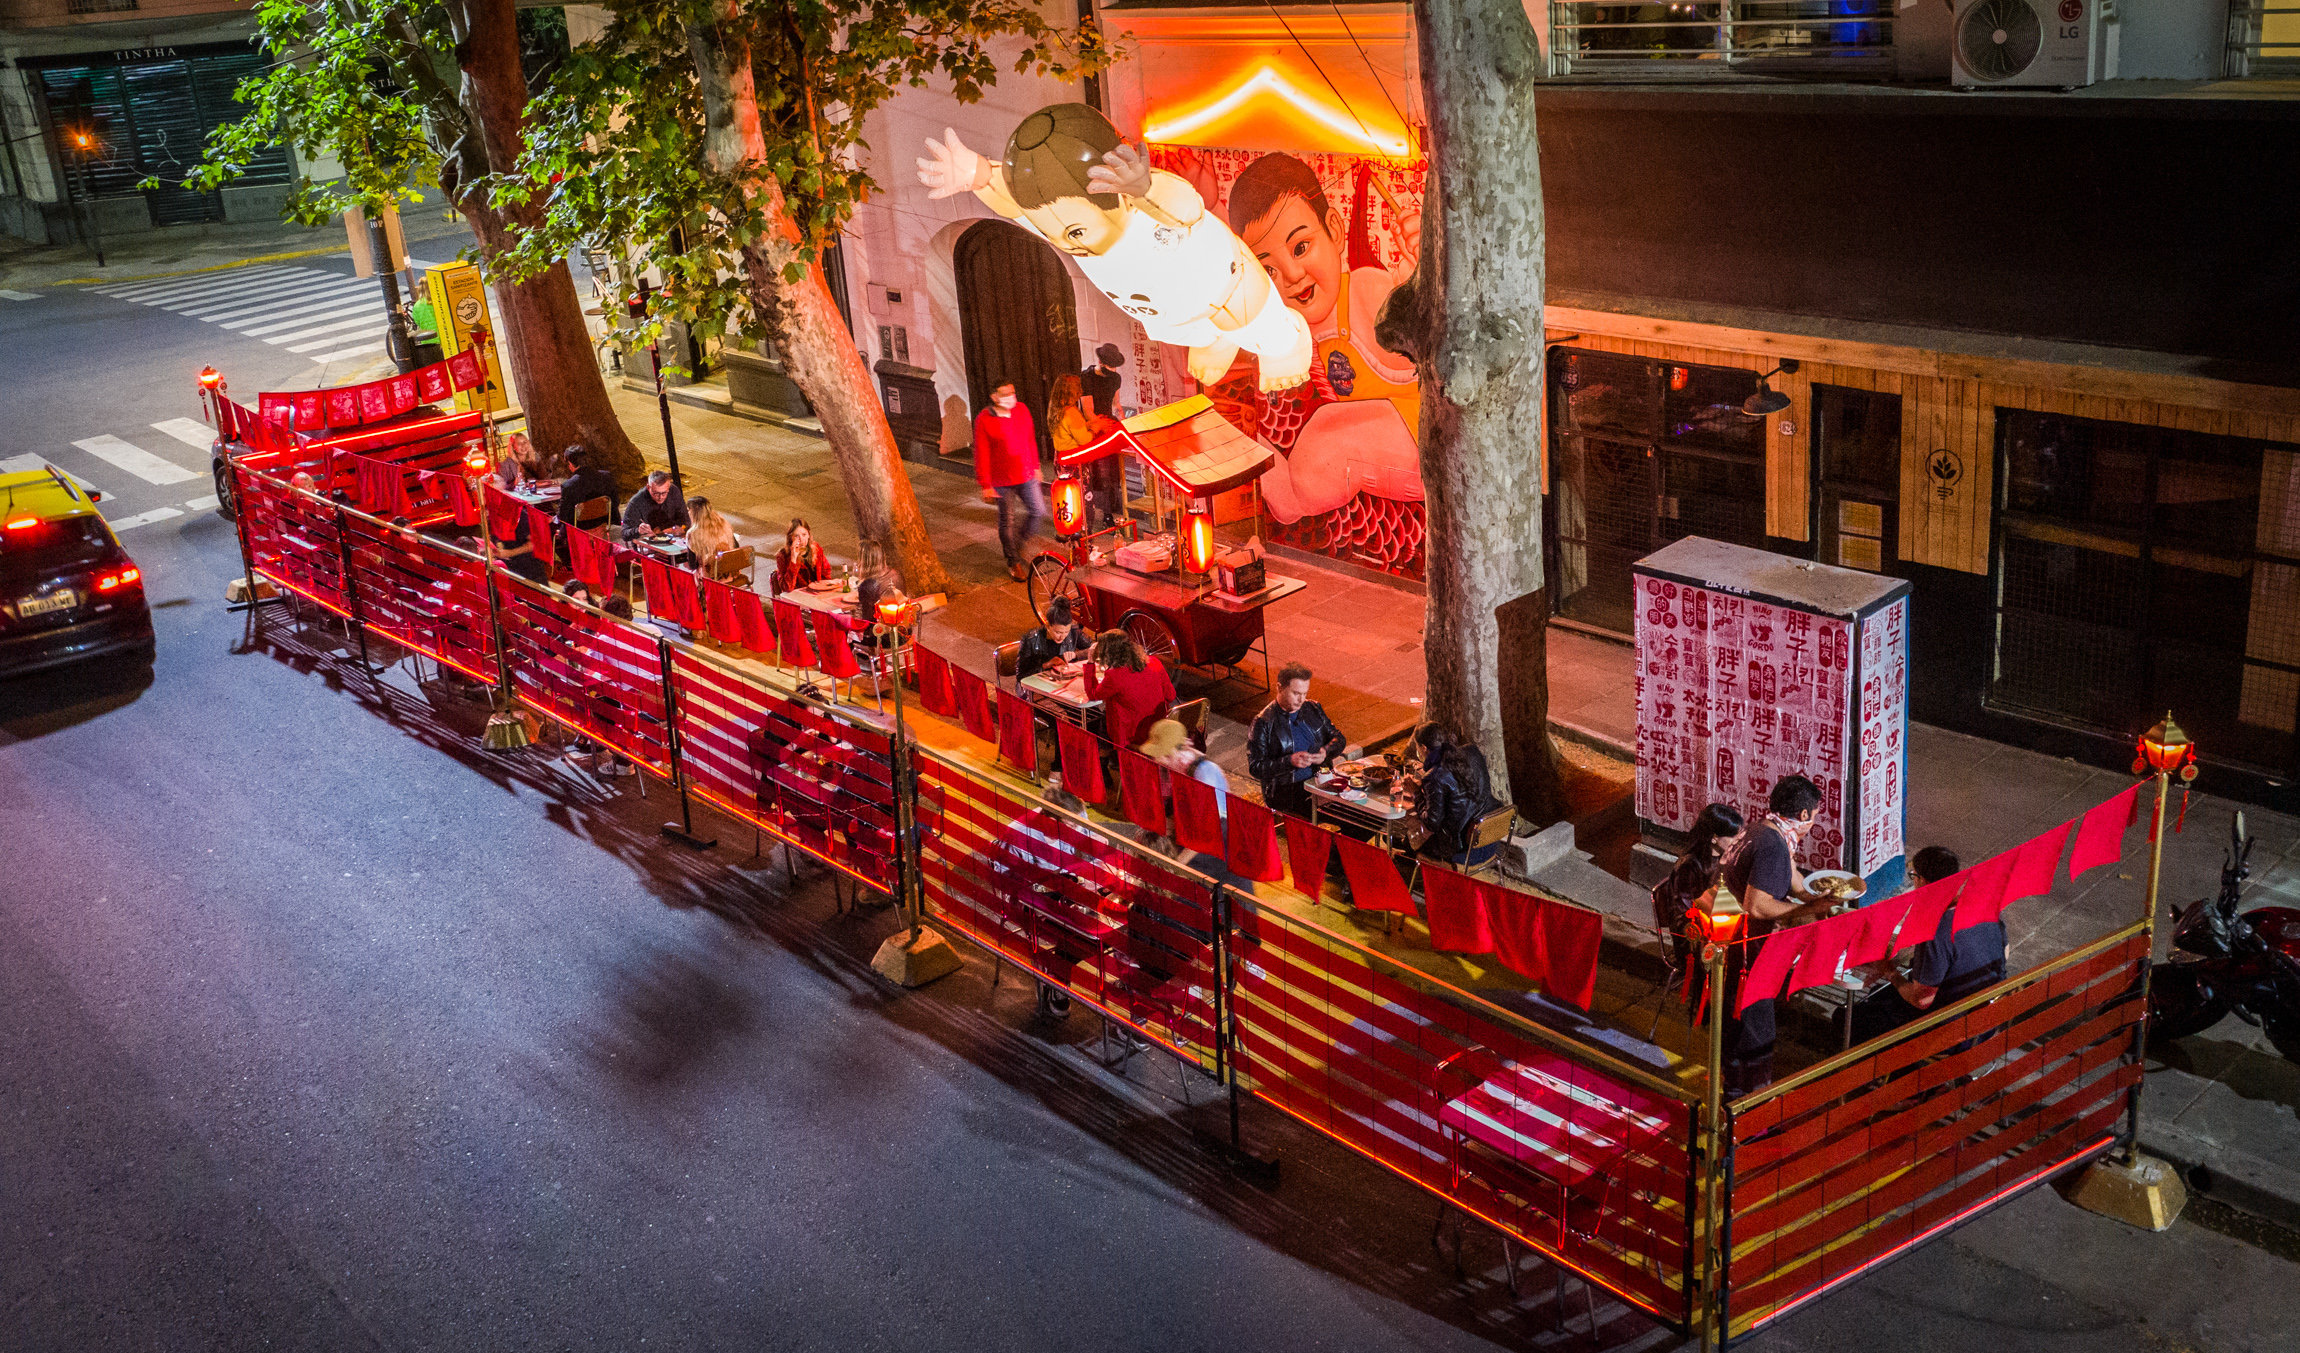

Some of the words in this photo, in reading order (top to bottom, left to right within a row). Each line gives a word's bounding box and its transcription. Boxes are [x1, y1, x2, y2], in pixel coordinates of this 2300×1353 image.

[2060, 26, 2079, 38] LG
[114, 47, 176, 60] TINTHA
[450, 281, 478, 290] SANITIZANTE
[1056, 500, 1073, 523] 福
[1648, 580, 1677, 599] 最好
[1656, 597, 1669, 612] 的
[1713, 595, 1744, 618] 치킨
[1752, 604, 1772, 616] NIÑO
[1648, 609, 1677, 628] 朋友
[1785, 610, 1811, 661] 胖子
[1887, 602, 1903, 656] 胖子
[1664, 634, 1678, 648] 수
[1748, 639, 1774, 652] GORDO
[1716, 646, 1740, 694] 胖子
[1895, 655, 1904, 669] 수
[1763, 665, 1775, 703] 永遠に
[1781, 662, 1814, 687] 치킨
[1657, 683, 1675, 694] NIÑO
[1683, 689, 1712, 710] 太った
[1715, 698, 1746, 721] 치킨
[1654, 716, 1677, 728] GORDO
[1751, 706, 1776, 755] 胖子
[1816, 723, 1843, 772] 胖子
[1750, 758, 1769, 770] NIÑO
[1864, 821, 1879, 873] 胖子
